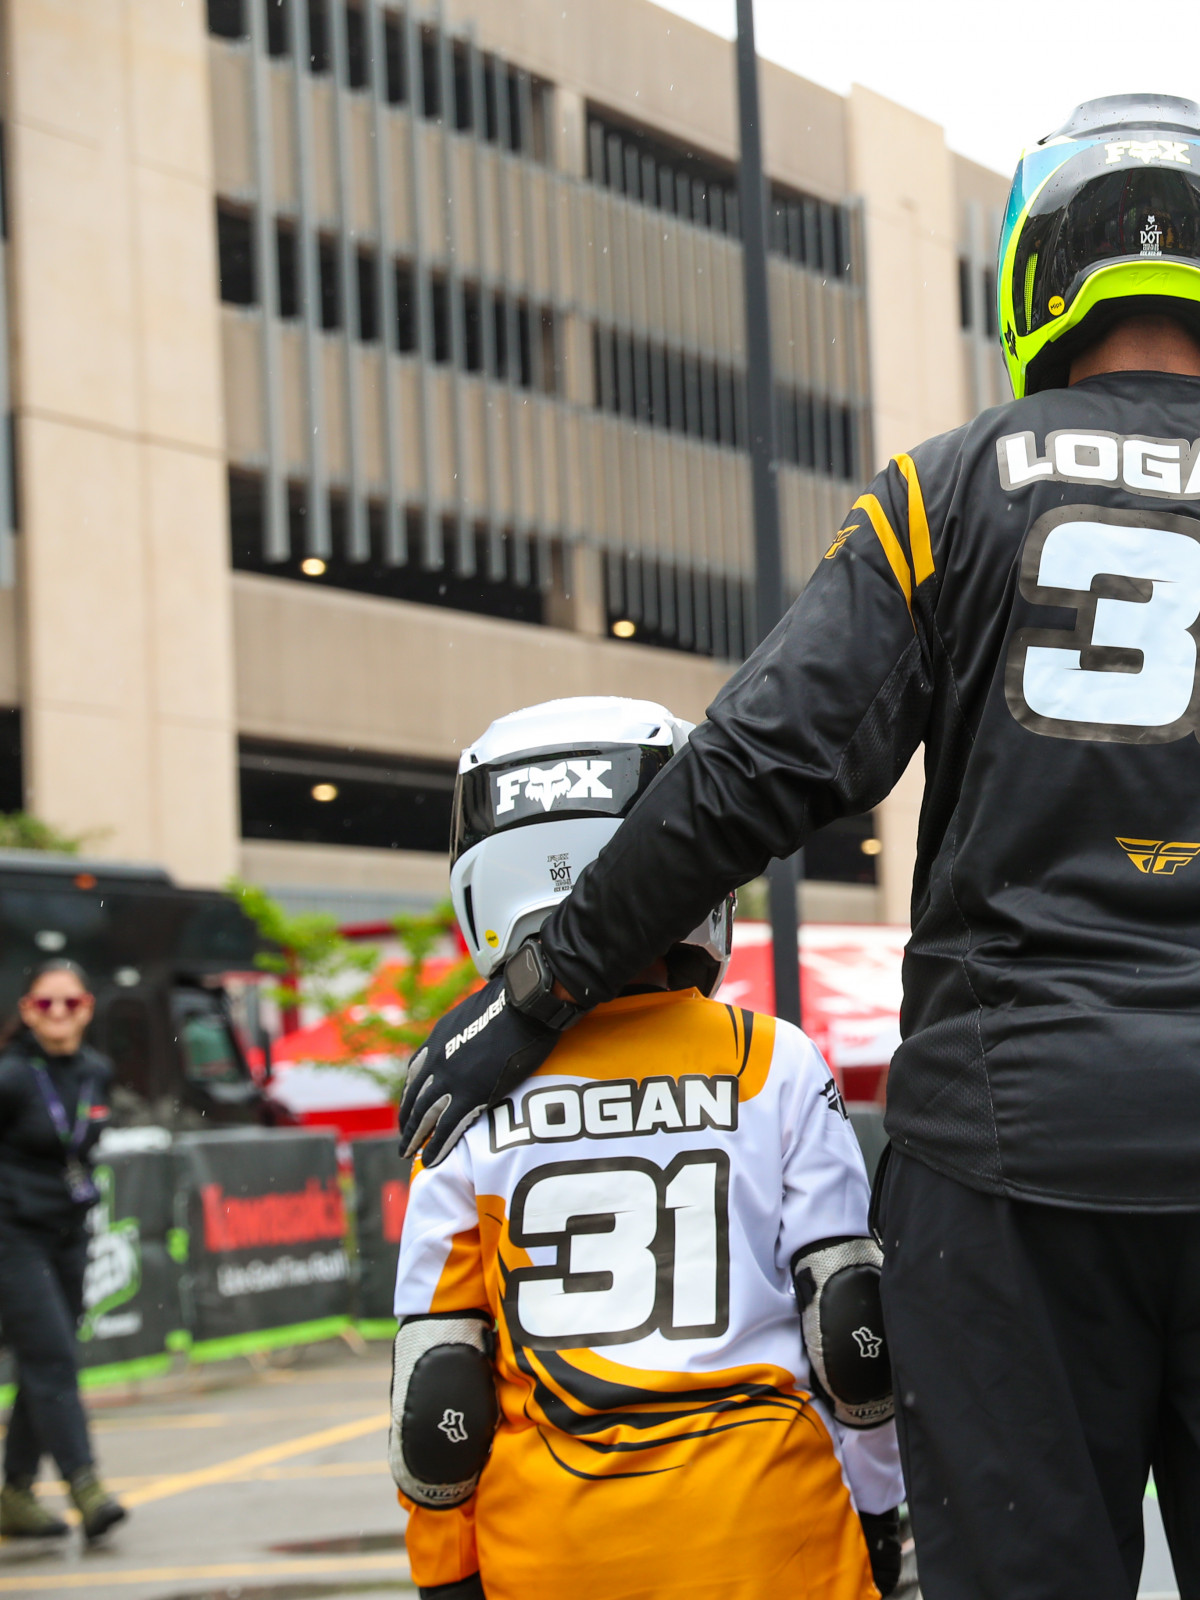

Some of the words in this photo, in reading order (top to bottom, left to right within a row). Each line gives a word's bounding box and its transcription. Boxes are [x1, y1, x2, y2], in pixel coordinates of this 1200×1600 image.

[1104, 140, 1192, 165] FOX
[1140, 230, 1162, 244] DOT
[496, 759, 613, 815] FOX
[549, 865, 572, 881] DOT
[491, 1076, 736, 1151] LOGAN
[513, 1156, 722, 1343] 31
